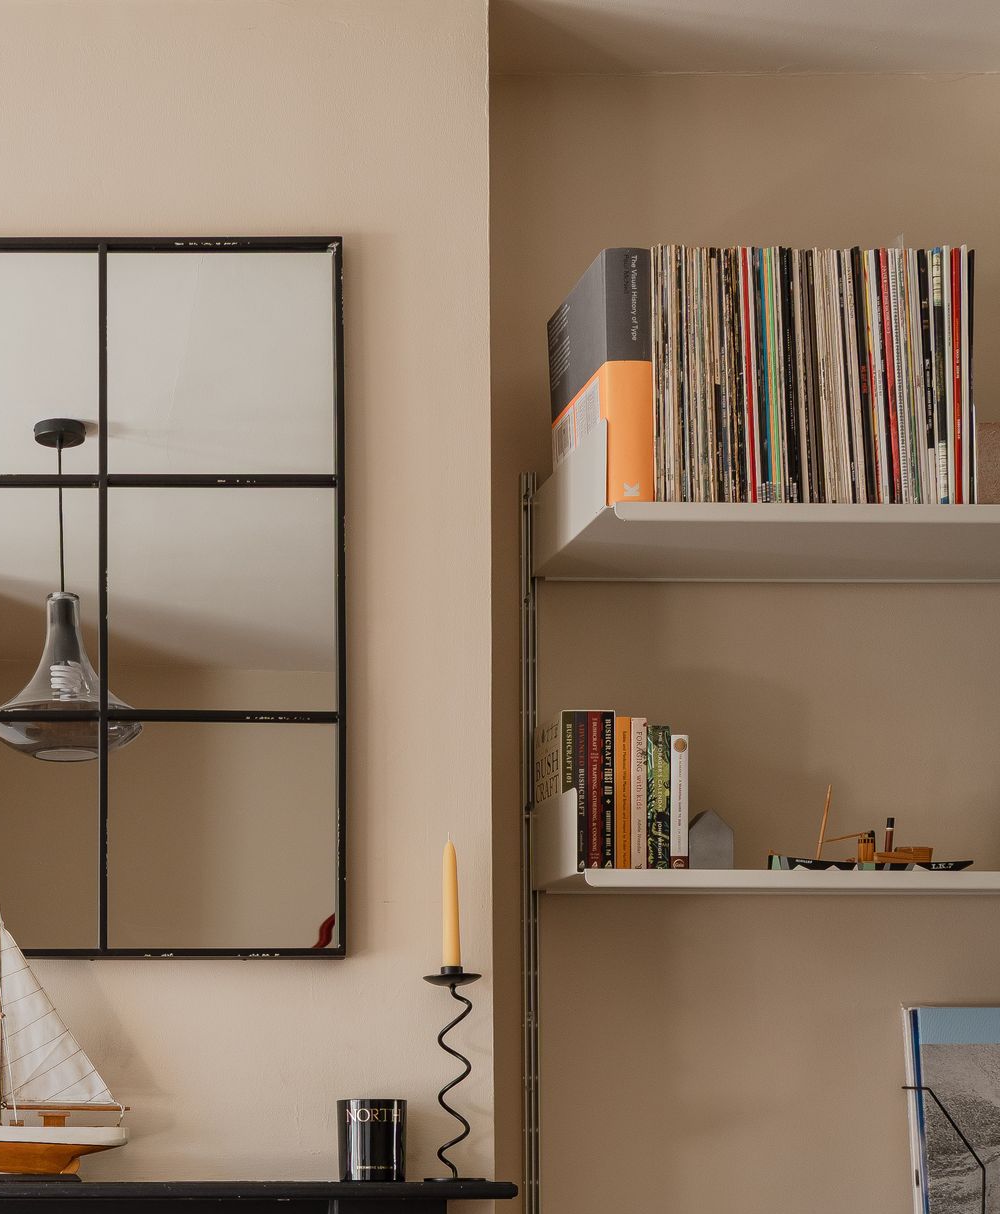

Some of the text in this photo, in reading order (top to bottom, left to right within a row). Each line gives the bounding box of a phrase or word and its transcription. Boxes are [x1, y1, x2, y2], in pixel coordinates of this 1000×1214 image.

[630, 255, 638, 341] The Visual History of Type
[536, 749, 559, 782] BUSH
[604, 719, 613, 795] BUSHCRAFT FIRST AID
[536, 774, 559, 803] CRAFT
[346, 1108, 401, 1123] NORTH
